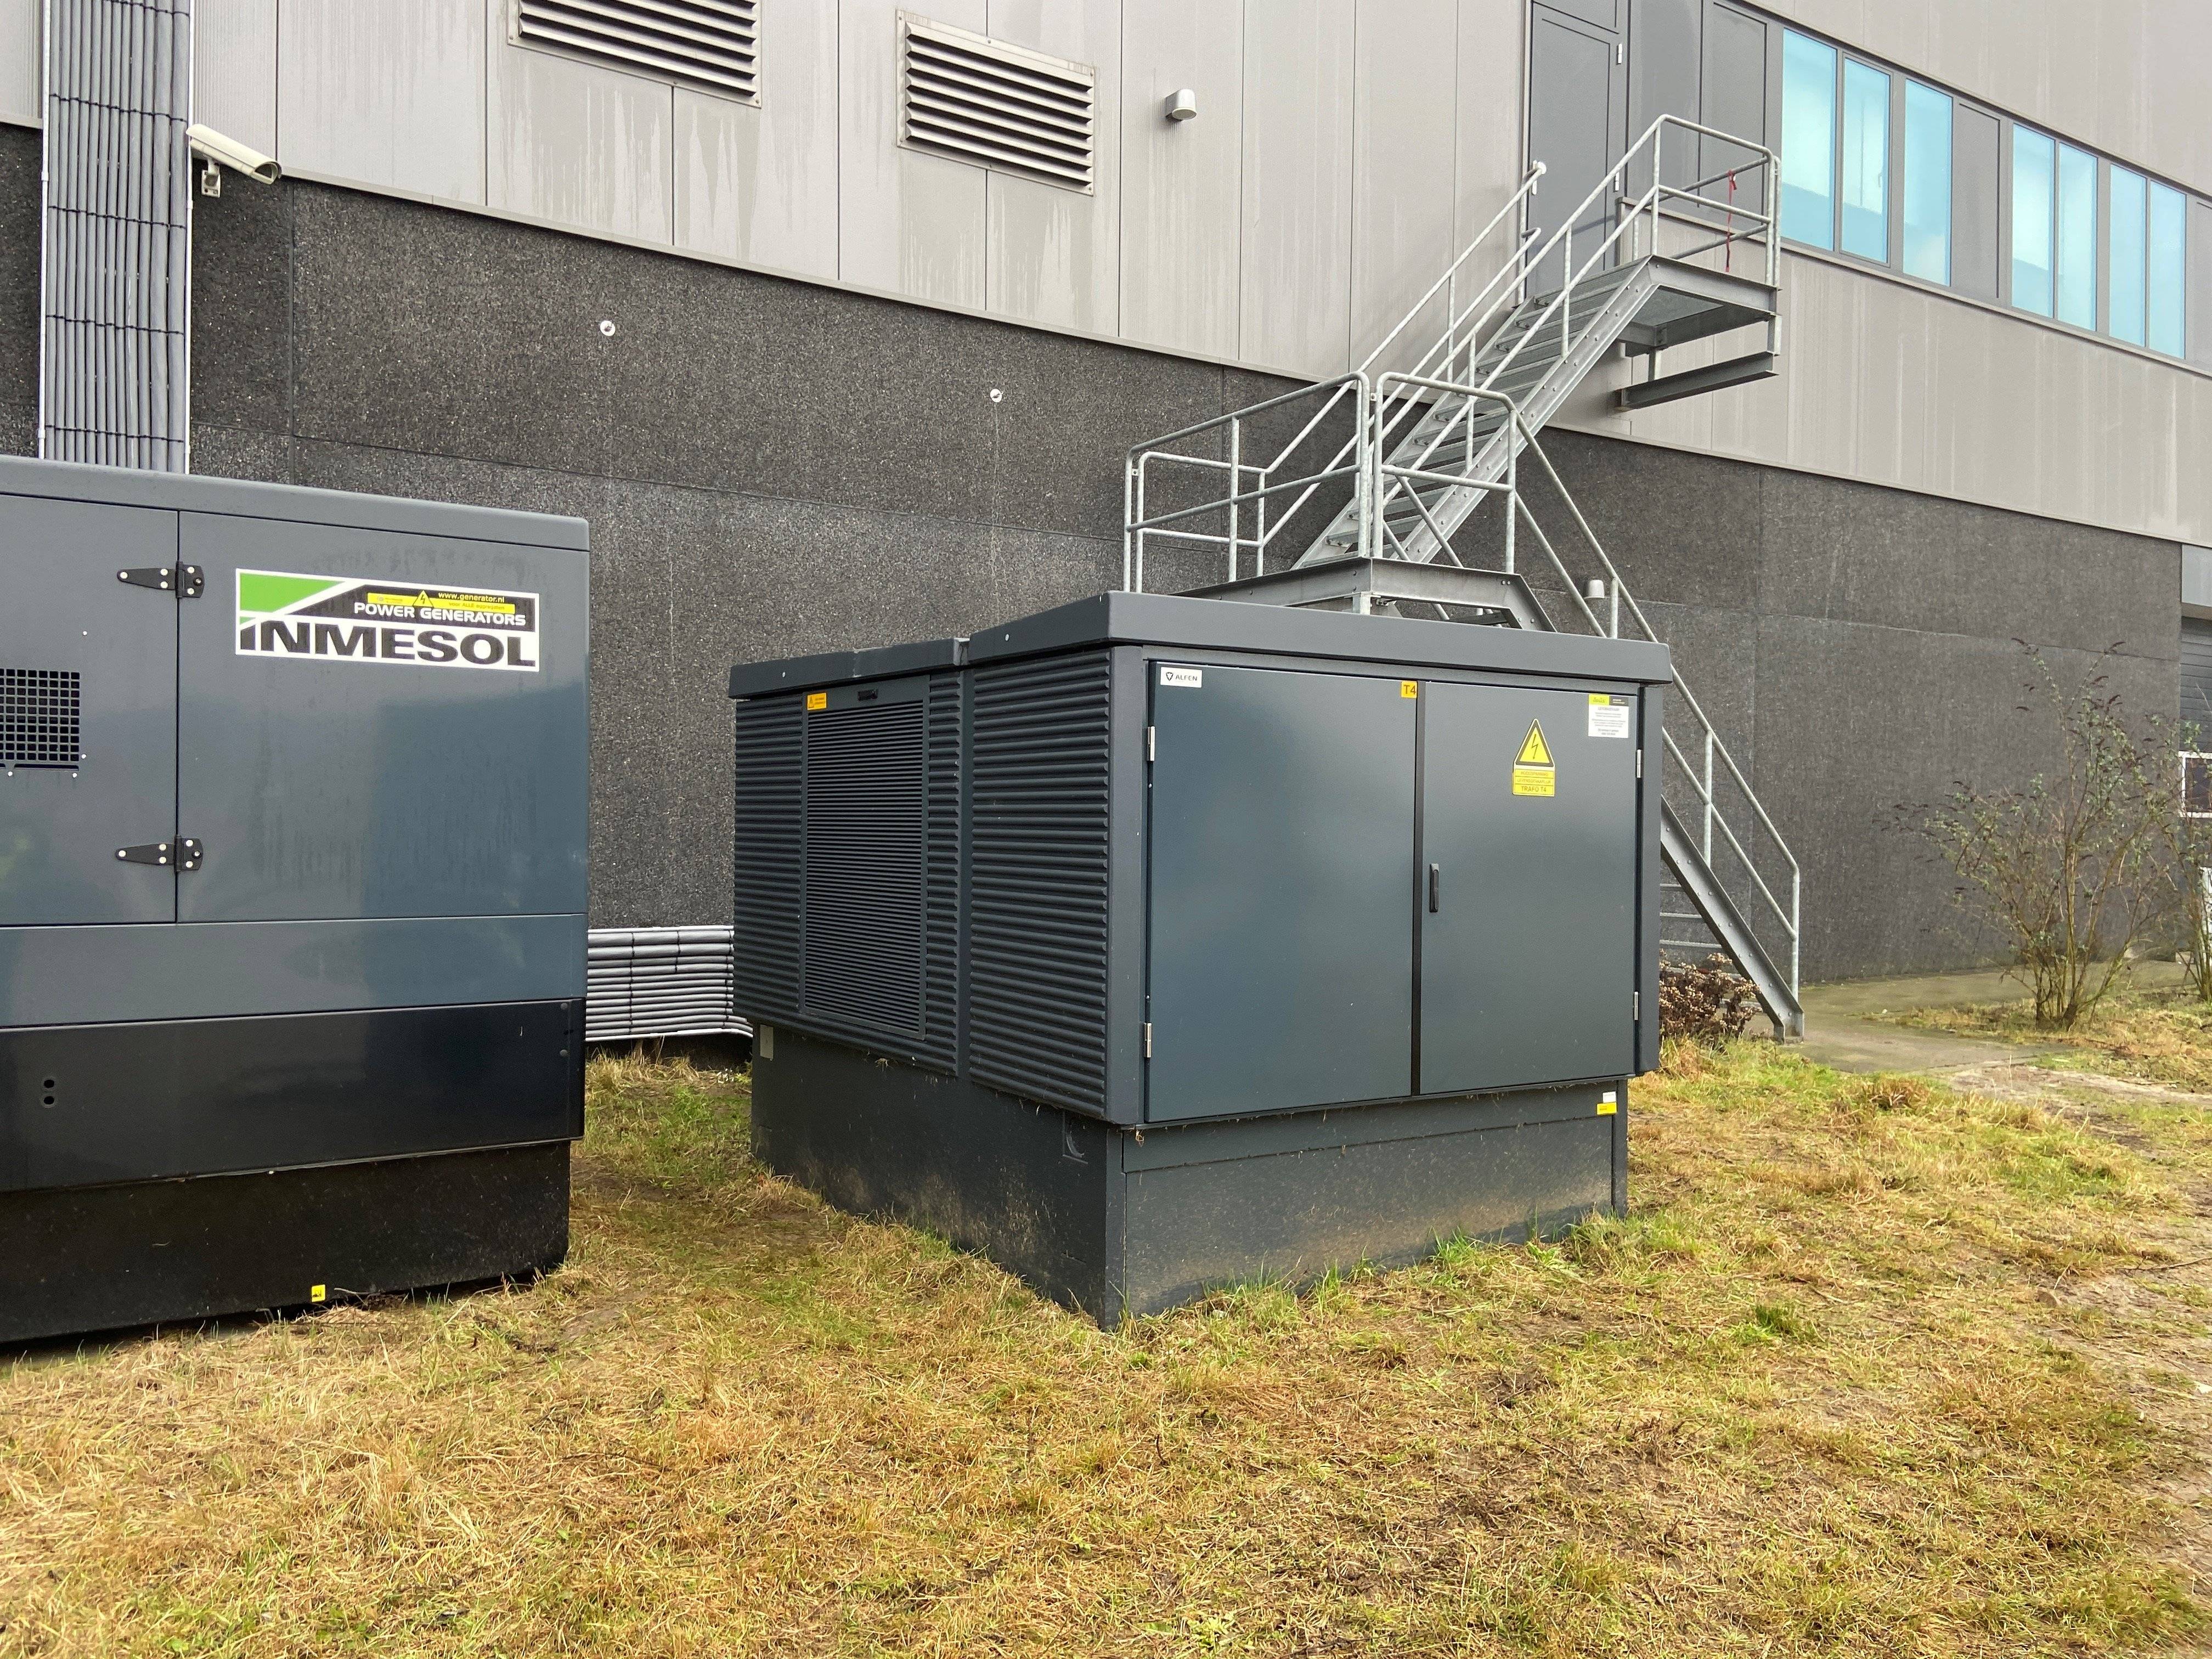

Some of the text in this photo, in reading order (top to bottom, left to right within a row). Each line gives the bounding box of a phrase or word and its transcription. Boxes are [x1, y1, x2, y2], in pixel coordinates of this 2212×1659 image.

[438, 592, 505, 603] www.generator.nl
[354, 602, 526, 626] POWER GENERATORS
[240, 620, 535, 667] INMESOL
[1403, 684, 1417, 695] T4
